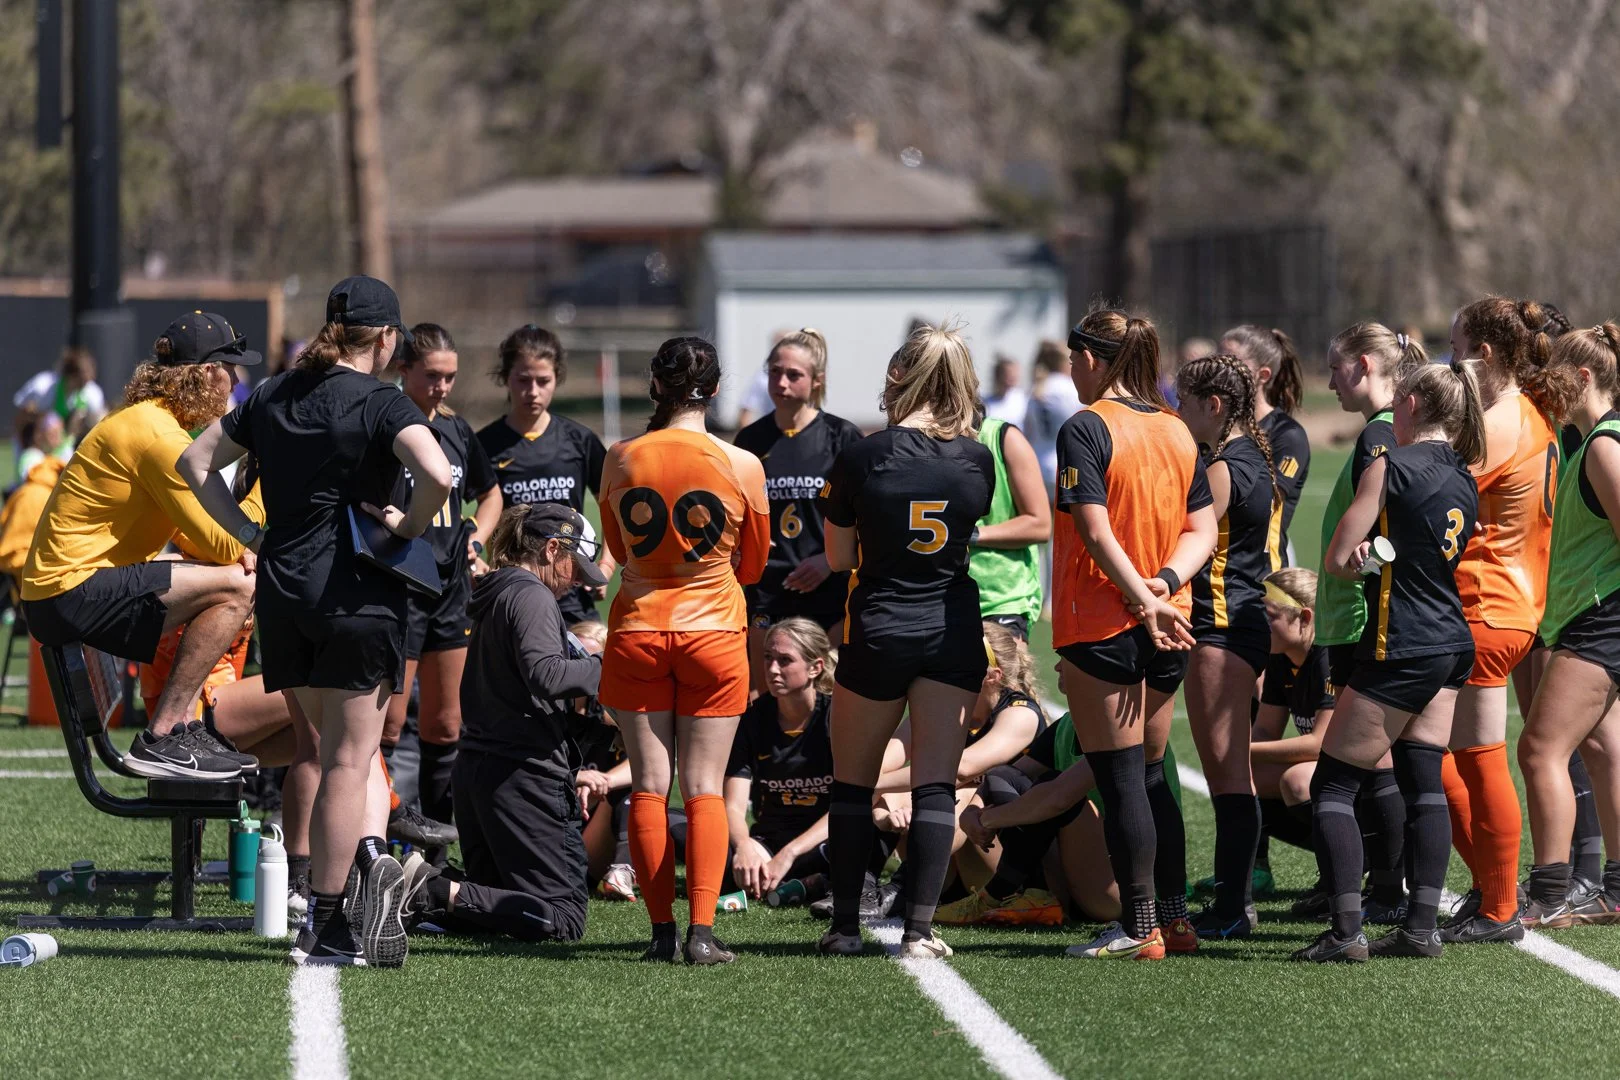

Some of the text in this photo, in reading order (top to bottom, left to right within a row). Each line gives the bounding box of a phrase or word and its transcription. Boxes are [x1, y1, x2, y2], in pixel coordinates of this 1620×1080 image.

[503, 476, 575, 494] COLORADO
[512, 488, 570, 504] COLLEGE
[766, 476, 825, 489] OLORADO
[769, 488, 817, 500] OLLEGE
[620, 486, 725, 563] 99
[780, 503, 803, 539] 6
[906, 500, 949, 555] 5
[1441, 508, 1464, 561] 3
